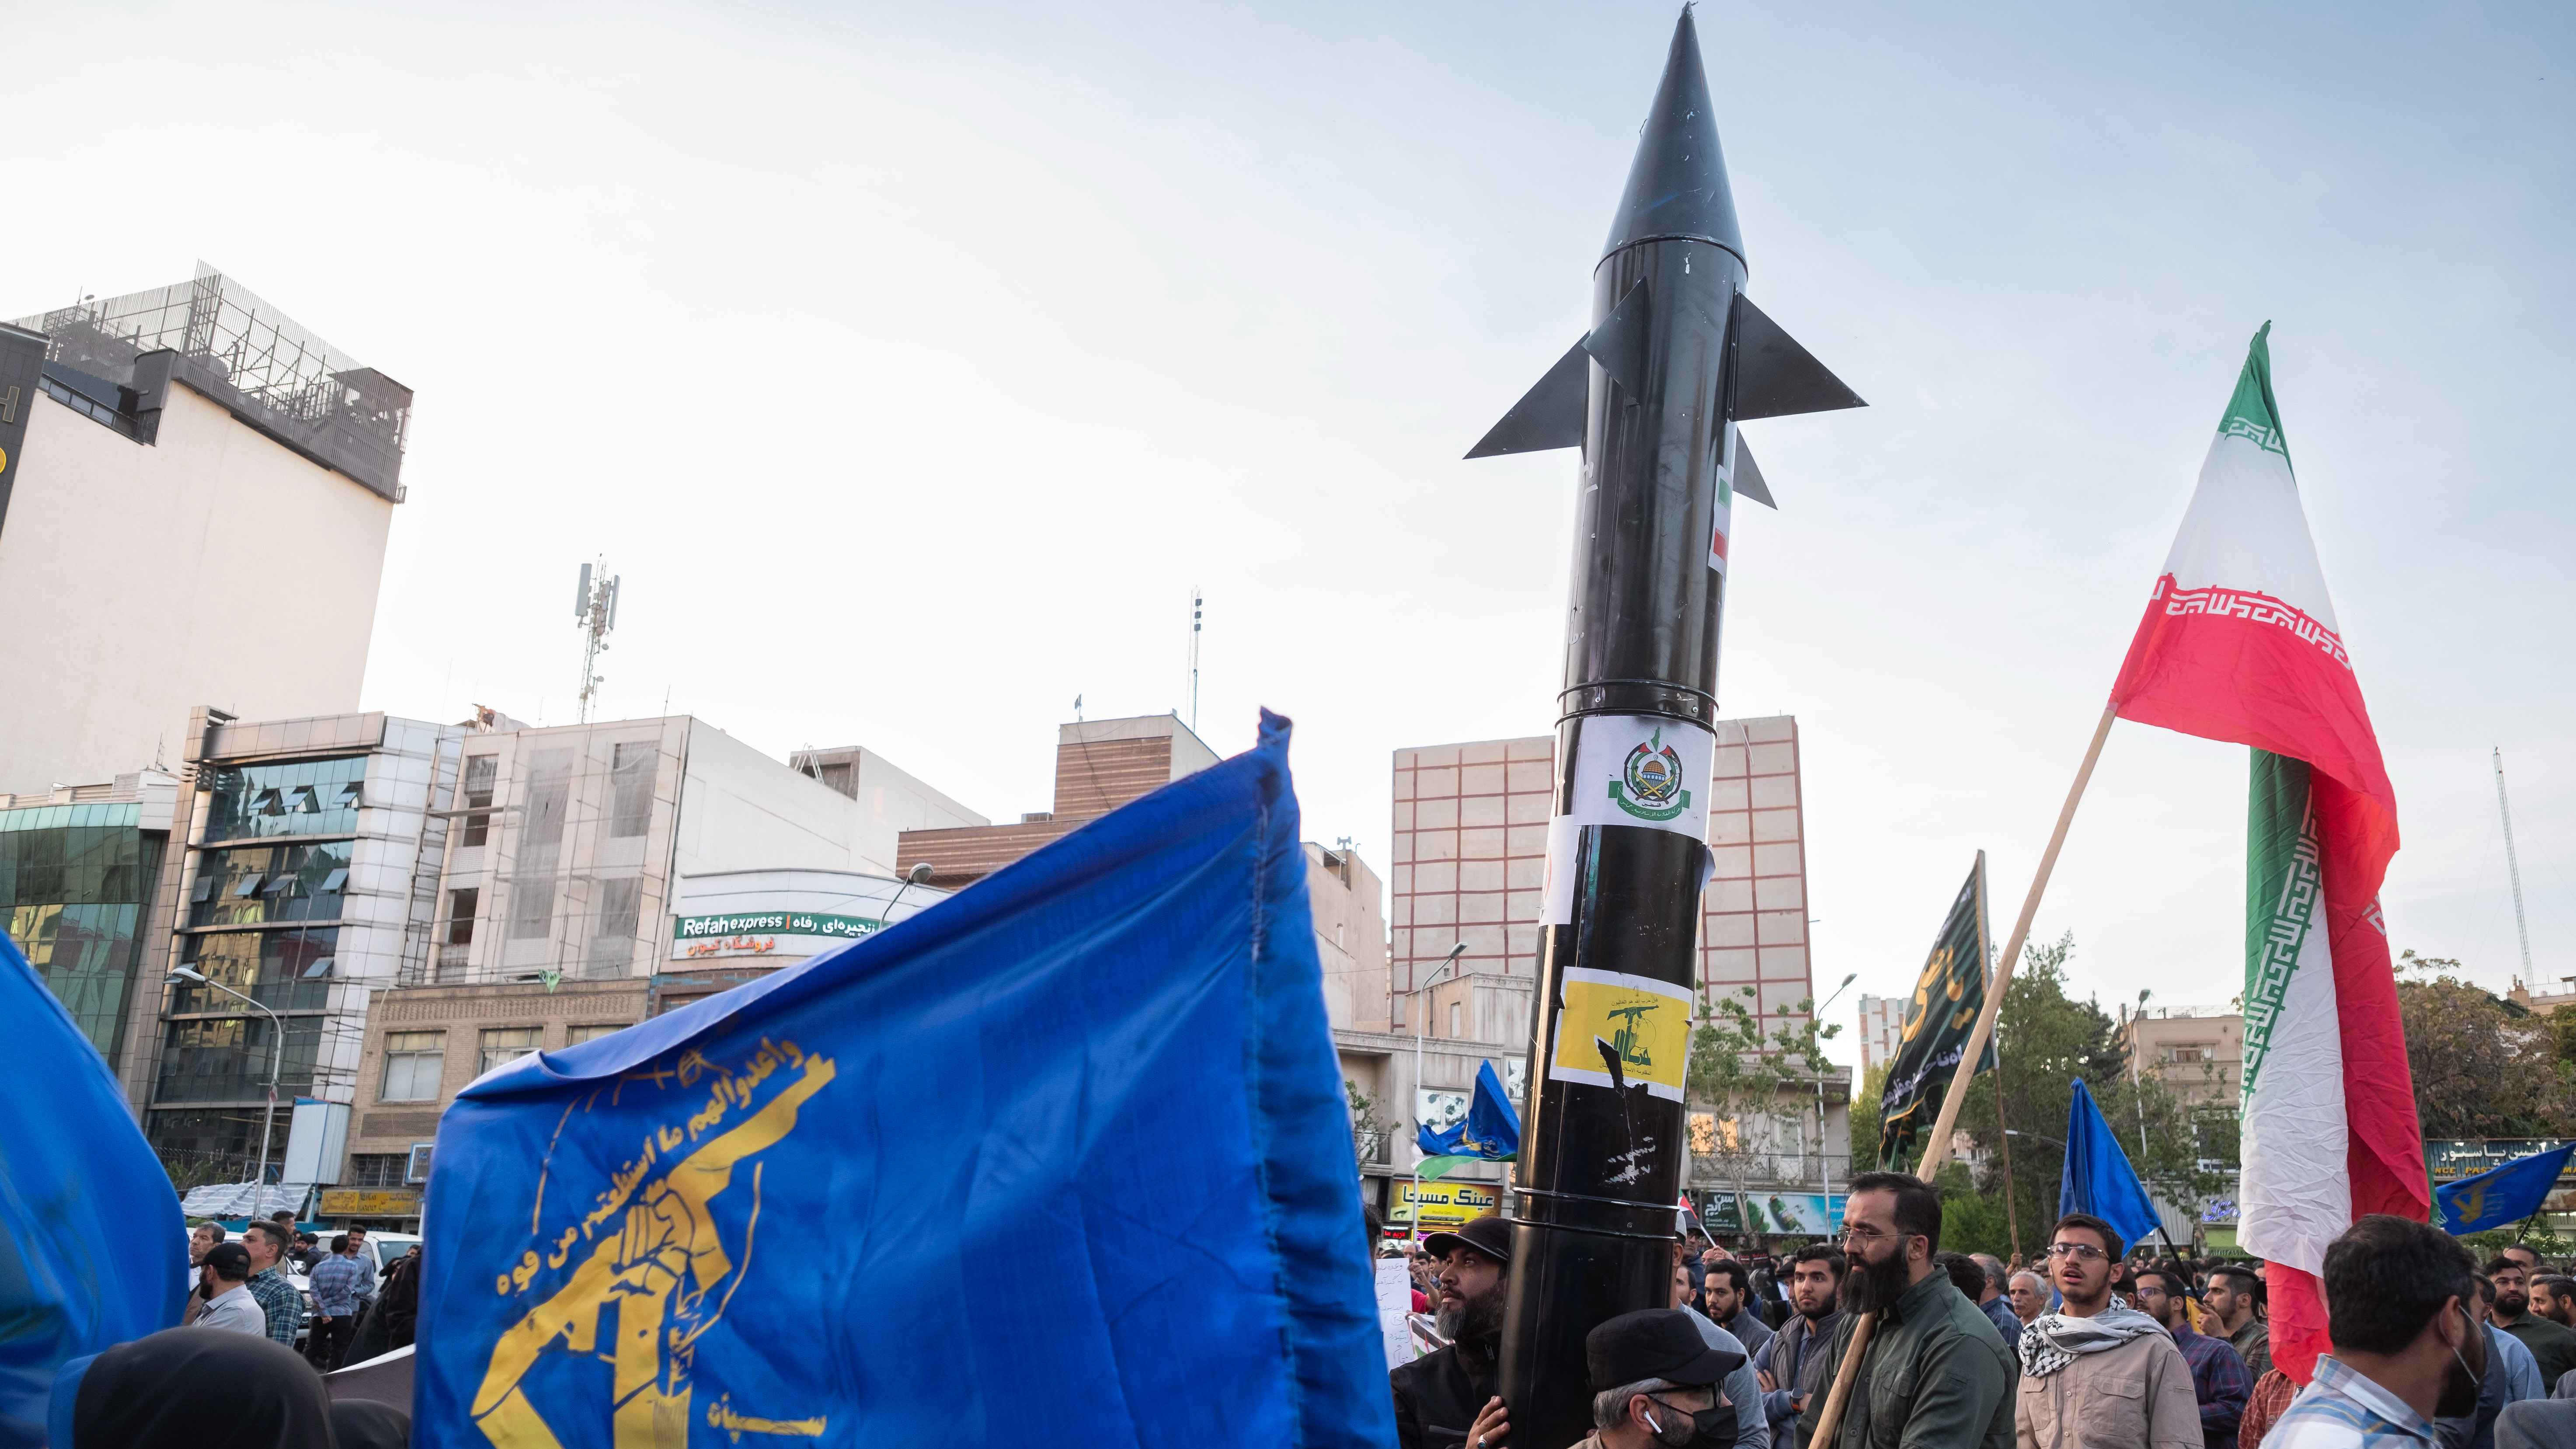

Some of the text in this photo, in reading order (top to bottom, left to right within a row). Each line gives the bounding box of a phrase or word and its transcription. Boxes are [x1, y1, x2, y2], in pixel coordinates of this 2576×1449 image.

[683, 915, 783, 936] Refah express
[793, 915, 817, 932] رفاه
[723, 935, 775, 952] فروشگاه
[2440, 1141, 2506, 1167] پاستور
[1454, 1189, 1495, 1211] عینک
